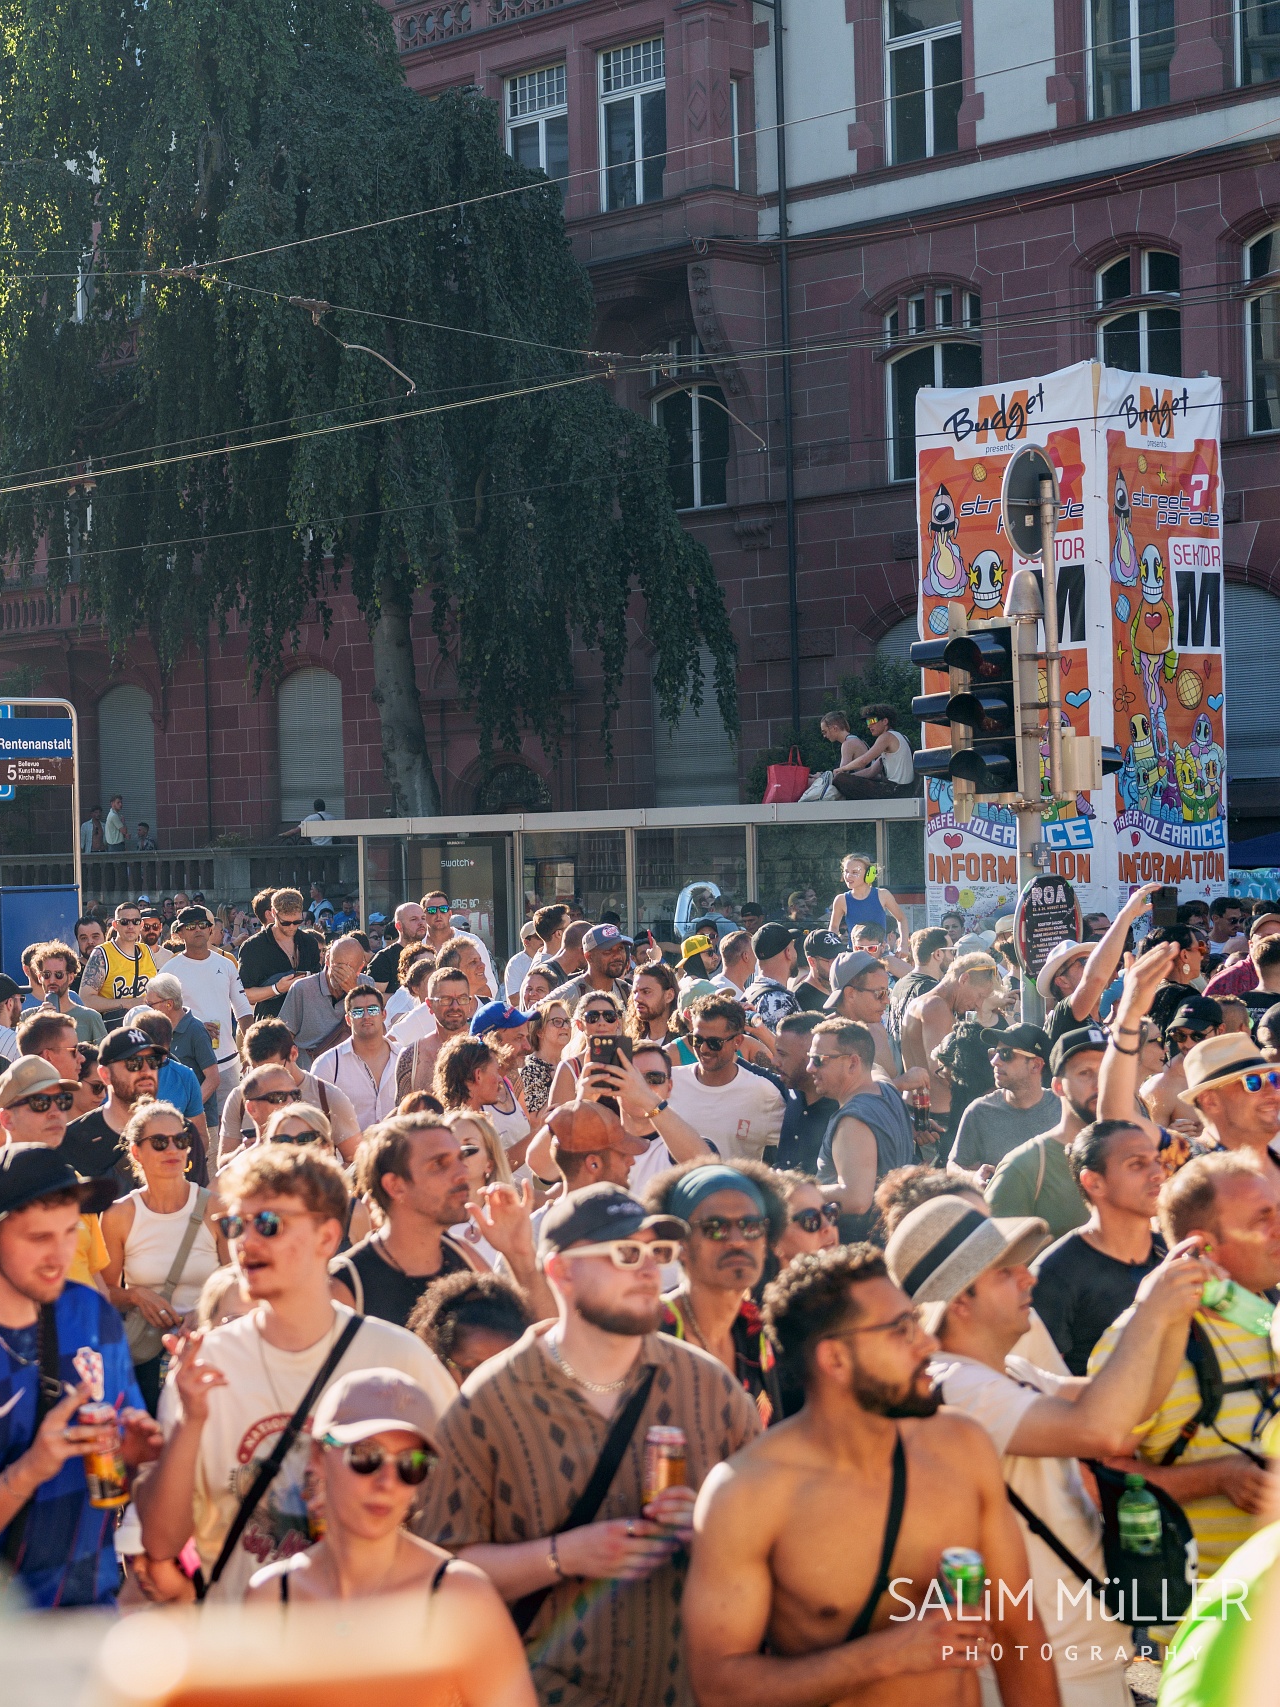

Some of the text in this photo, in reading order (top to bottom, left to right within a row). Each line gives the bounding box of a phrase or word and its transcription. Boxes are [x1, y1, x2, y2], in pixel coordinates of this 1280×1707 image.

[943, 382, 1045, 442] Budget
[1119, 387, 1189, 438] Budget
[985, 443, 1016, 455] presents:
[1131, 486, 1191, 510] street
[1156, 505, 1220, 530] parade
[1173, 543, 1221, 567] SEKTOR
[1174, 570, 1221, 648] M
[6, 764, 17, 781] 5
[440, 858, 470, 868] swatch
[928, 851, 1091, 885] INFORMION
[1118, 850, 1226, 885] INFORMATION
[1031, 884, 1067, 906] ROA
[127, 1029, 146, 1043] NY
